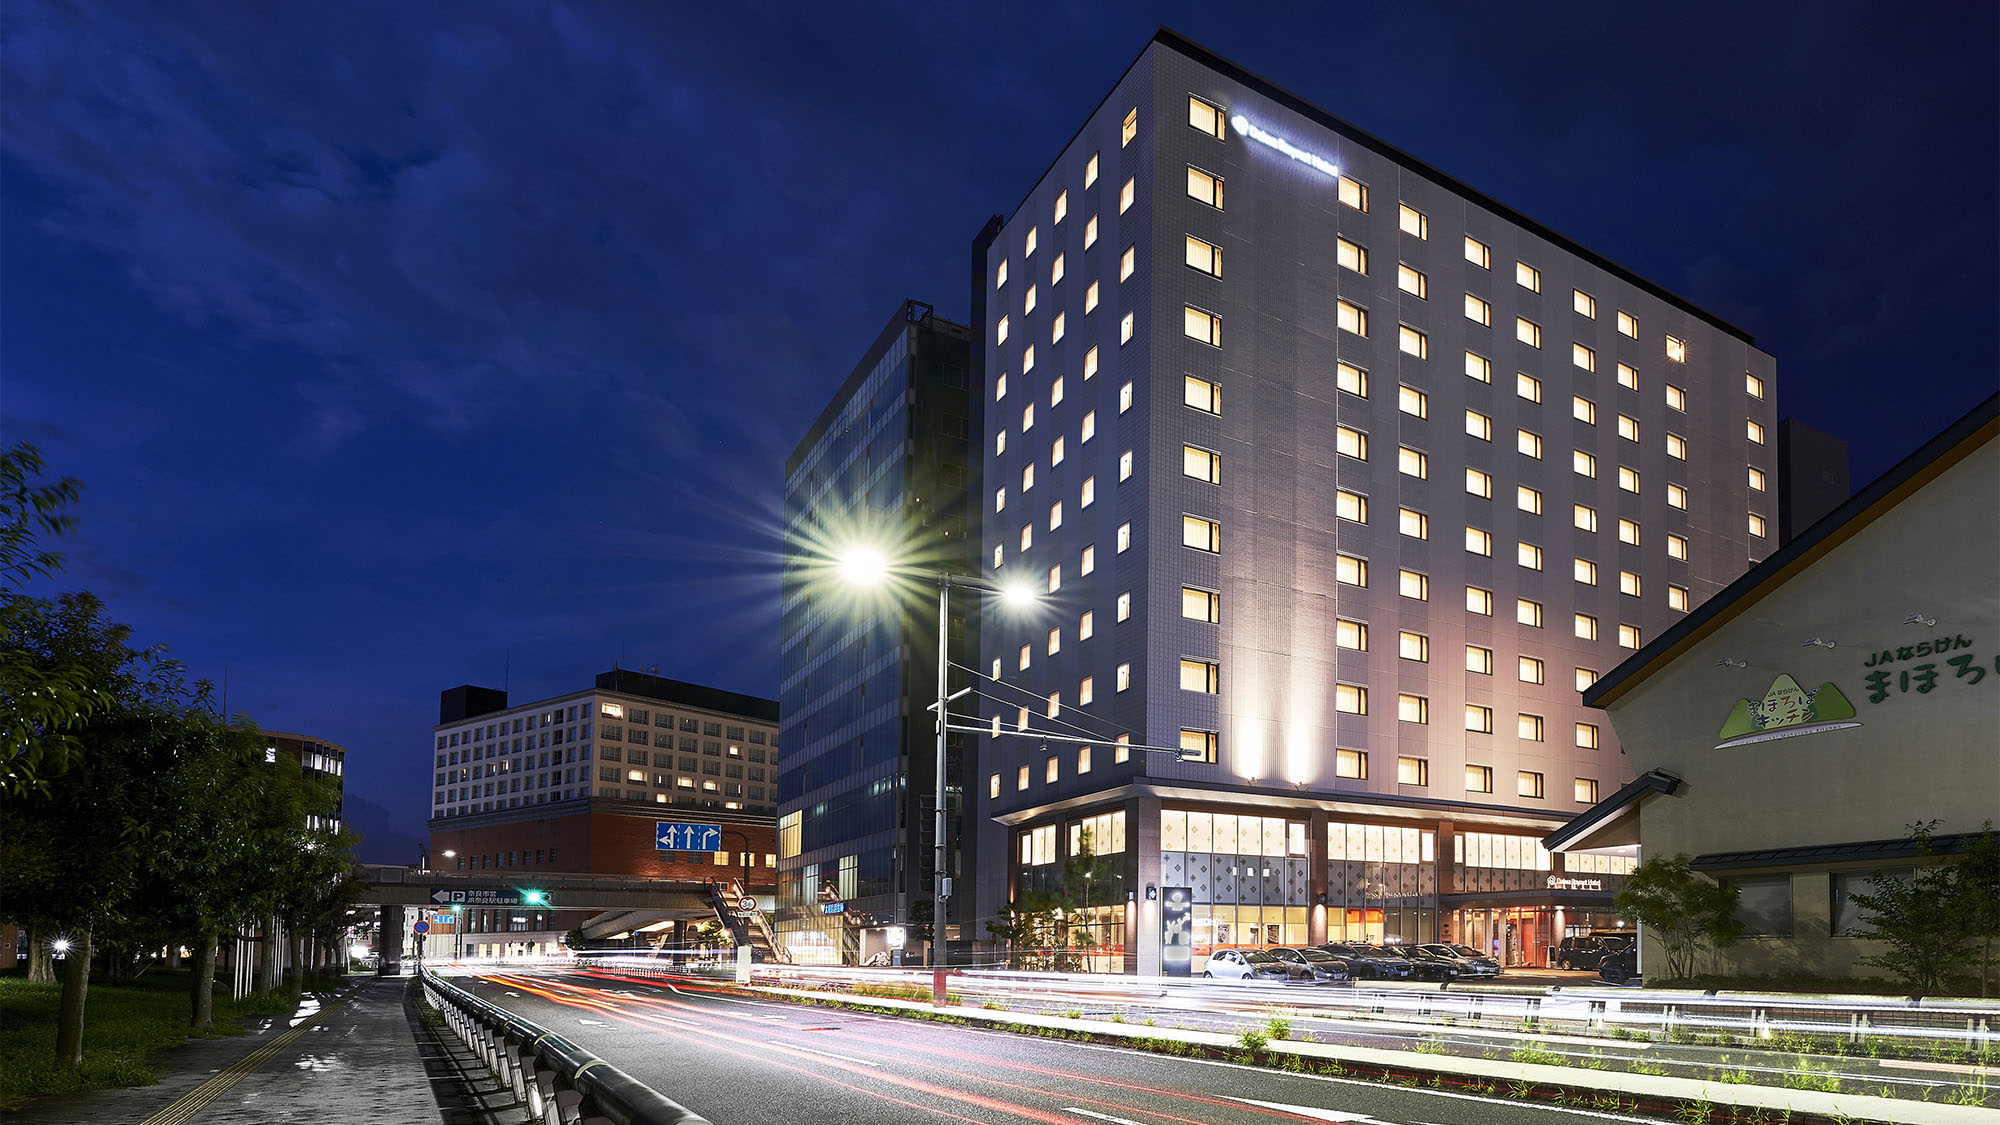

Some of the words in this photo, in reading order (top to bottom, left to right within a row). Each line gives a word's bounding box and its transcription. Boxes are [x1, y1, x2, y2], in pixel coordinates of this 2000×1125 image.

[1864, 634, 1973, 668] JAならけん
[1865, 654, 2000, 704] まほろ
[1756, 708, 1814, 727] キッチン
